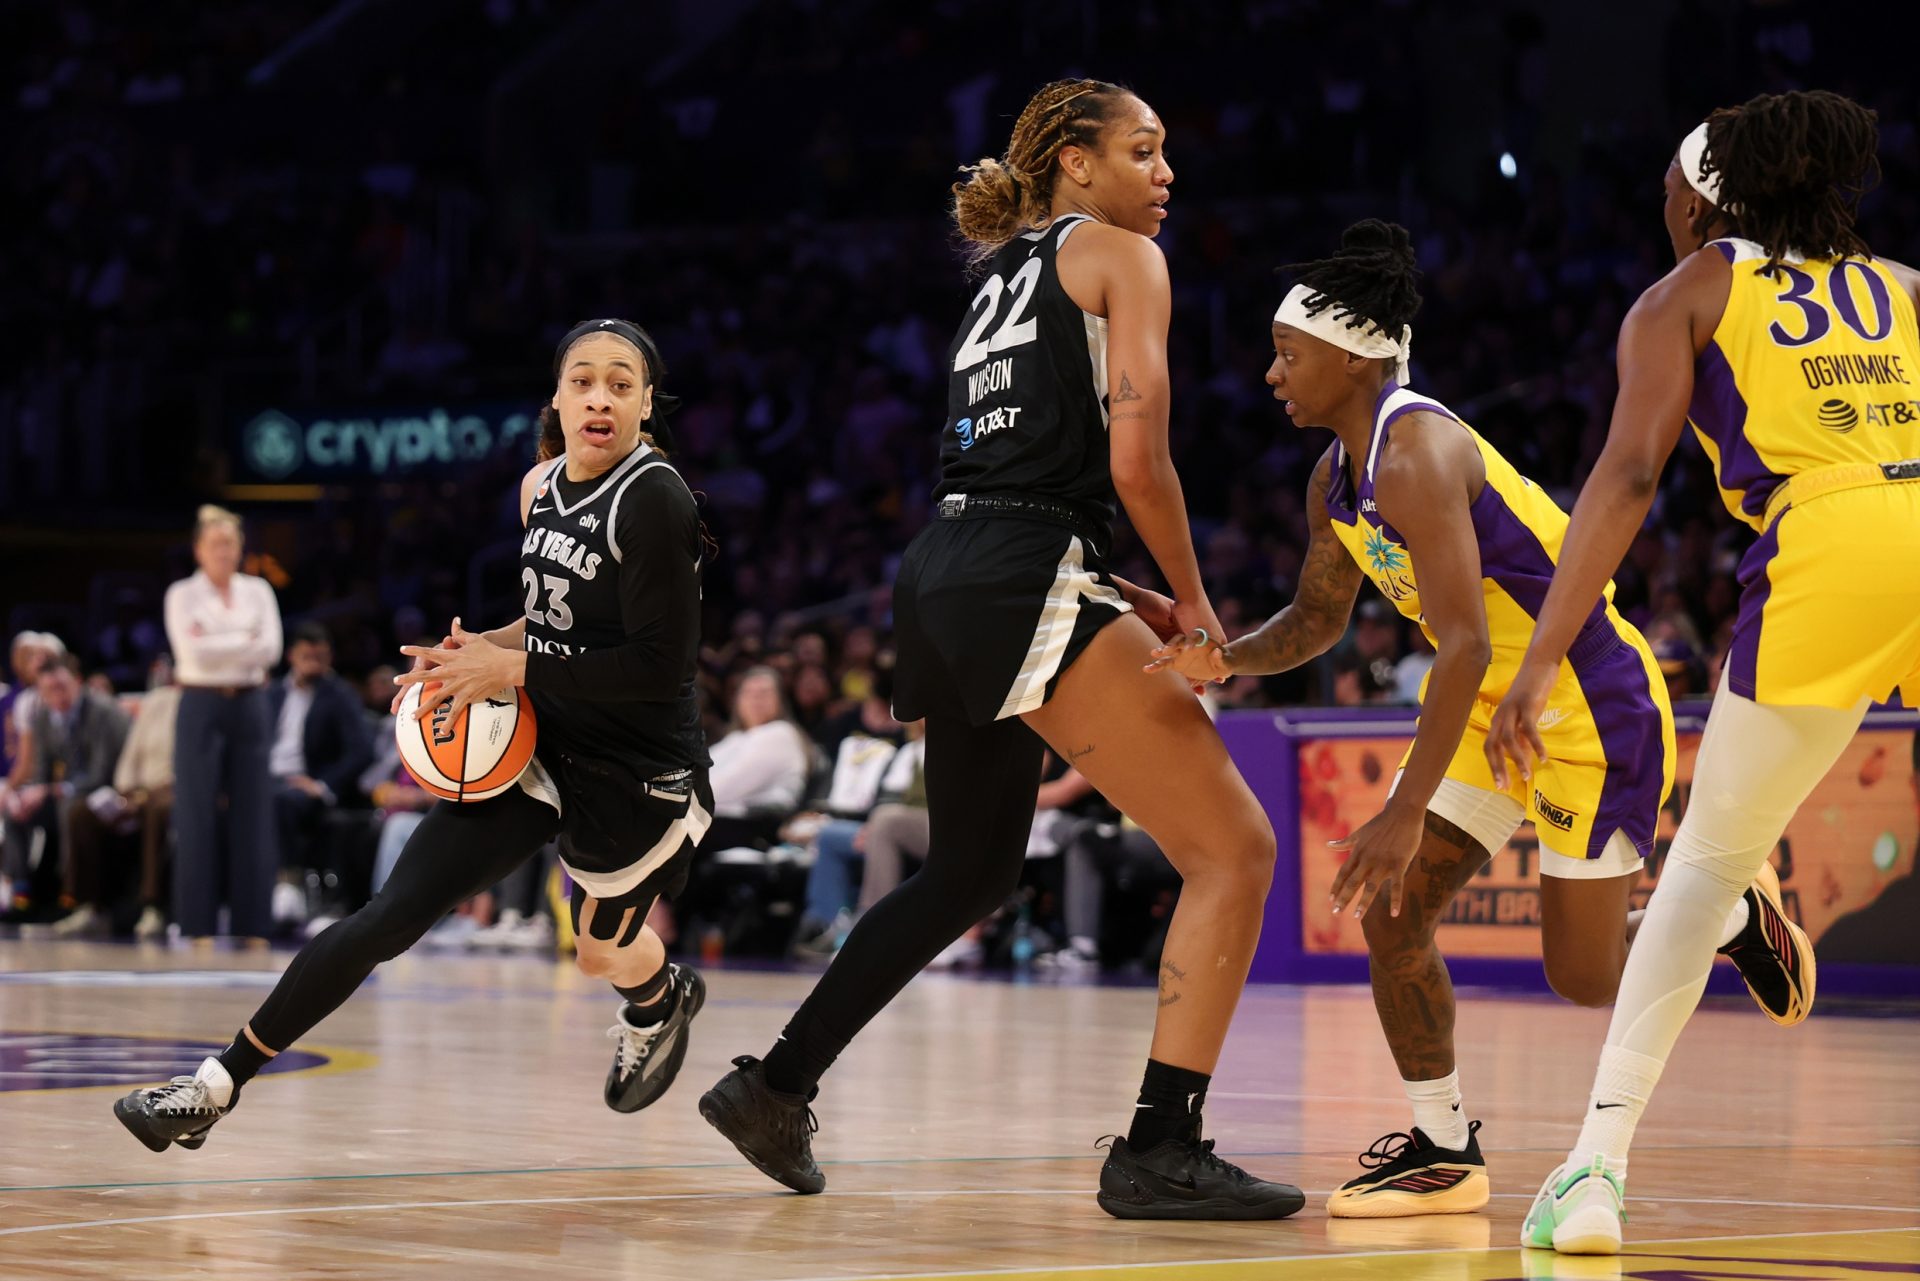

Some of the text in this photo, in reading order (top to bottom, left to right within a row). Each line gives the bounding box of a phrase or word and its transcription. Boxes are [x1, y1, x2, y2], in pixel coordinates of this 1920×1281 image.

[953, 256, 1042, 372] 22
[1764, 260, 1893, 347] 30
[968, 357, 1014, 407] WILSON
[1800, 354, 1911, 390] OGWUMIKE
[974, 406, 1021, 439] AT&T
[578, 513, 601, 534] ally
[540, 530, 603, 581] VEGAS
[522, 566, 574, 632] 23
[1540, 801, 1574, 829] WNBA
